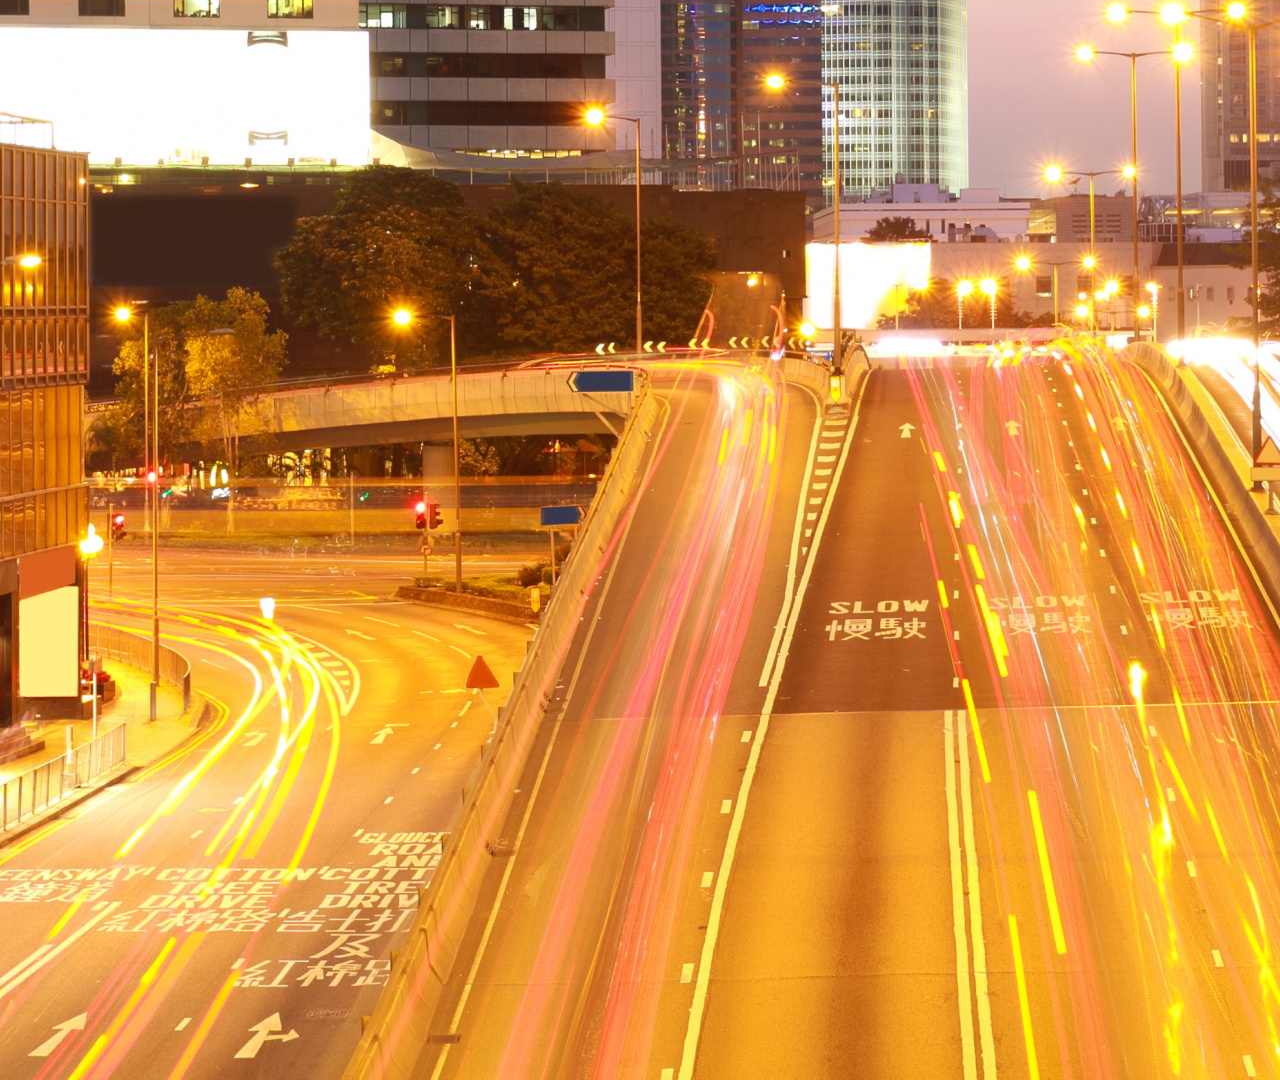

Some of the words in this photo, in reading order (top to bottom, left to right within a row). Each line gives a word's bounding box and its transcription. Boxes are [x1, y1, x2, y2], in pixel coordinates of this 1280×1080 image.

[988, 595, 1086, 609] SLOW
[1140, 589, 1240, 603] SLOW
[829, 600, 929, 614] SLOW
[990, 612, 1092, 635] 慢駛
[1146, 607, 1254, 629] 慢駛
[825, 617, 927, 641] 慢駛
[155, 867, 317, 881] COTTON
[168, 881, 281, 895] TREE
[343, 881, 430, 895] TRE
[138, 894, 278, 909] DRIVE
[96, 908, 277, 932] 紅棉路
[309, 933, 382, 959] 及
